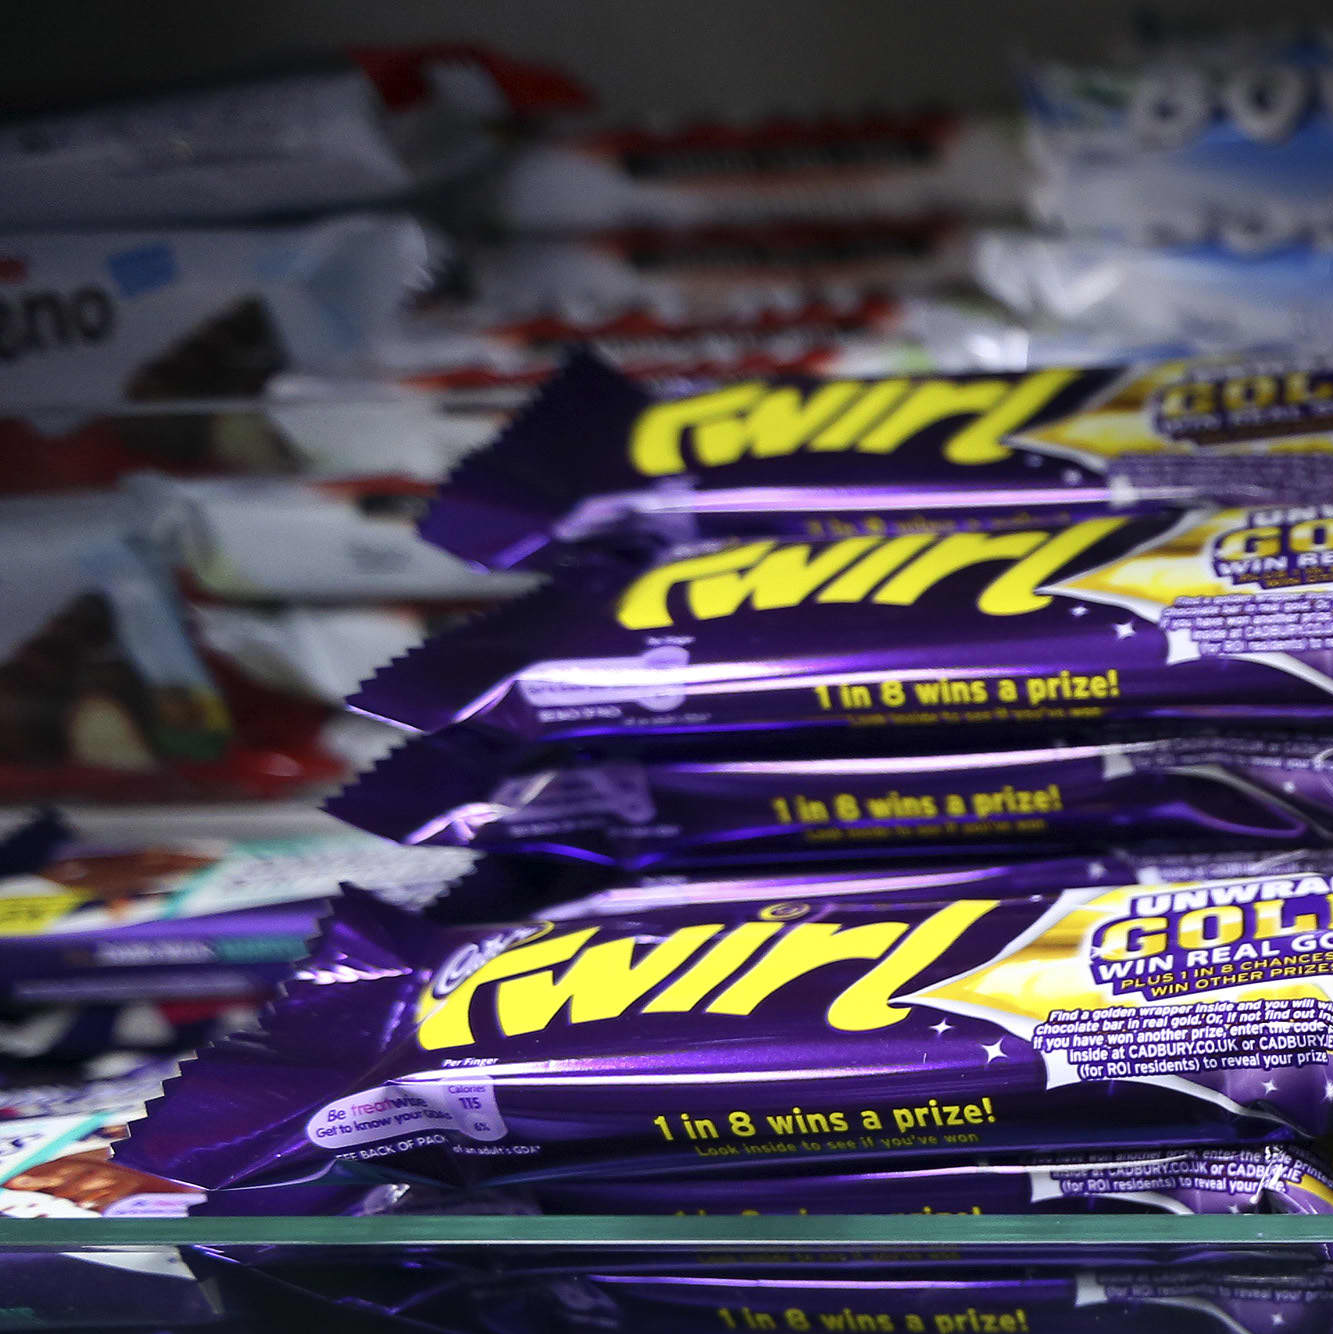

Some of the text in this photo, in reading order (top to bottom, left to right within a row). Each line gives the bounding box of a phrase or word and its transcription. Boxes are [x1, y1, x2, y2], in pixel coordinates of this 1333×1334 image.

[616, 517, 1129, 630] Twirl
[1217, 556, 1288, 575] WIN
[813, 669, 1120, 710] 1 in 8 wins a prize!
[1100, 952, 1180, 981] WIN
[1186, 940, 1280, 968] REAL
[418, 899, 1000, 1051] Twirl
[1121, 971, 1175, 990] PLUS
[1179, 968, 1189, 982] 1
[1193, 965, 1215, 980] IN
[1220, 962, 1236, 975] 8
[1151, 981, 1191, 998] WIN
[1195, 970, 1264, 990] OTHER
[1036, 1020, 1100, 1035] chocolate
[1102, 1019, 1125, 1033] bar
[1128, 1018, 1140, 1031] in
[1143, 1015, 1167, 1029] real
[1239, 1011, 1261, 1022] not
[1264, 1009, 1291, 1022] find
[1293, 1009, 1316, 1020] out
[1050, 1010, 1079, 1022] Find
[1093, 1007, 1136, 1022] golden
[1139, 1004, 1191, 1019] wrapper
[1237, 1000, 1262, 1011] and
[1264, 1000, 1289, 1012] you
[1293, 999, 1315, 1009] will
[1033, 1036, 1044, 1050] if
[1045, 1036, 1070, 1053] you
[1073, 1033, 1105, 1048] have
[1107, 1033, 1134, 1045] won
[1137, 1028, 1189, 1043] another
[1230, 1023, 1267, 1036] enter
[1293, 1019, 1325, 1033] code
[1111, 1046, 1126, 1060] at
[1129, 1037, 1239, 1058] CADBURY.CO.UK
[1241, 1039, 1256, 1051] or
[442, 1056, 500, 1068] Per Finger
[1080, 1063, 1103, 1079] (for
[1107, 1062, 1131, 1076] ROI
[1135, 1057, 1200, 1075] residents)
[1203, 1056, 1218, 1069] to
[1222, 1052, 1260, 1067] reveal
[1263, 1052, 1293, 1069] your
[316, 1124, 338, 1139] Get
[339, 1122, 354, 1135] to
[354, 1117, 392, 1132] know
[394, 1110, 426, 1126] your
[653, 1097, 997, 1141] 1 in 8 wins a prize!
[695, 1143, 741, 1158] Look
[742, 1140, 798, 1156] inside
[801, 1139, 823, 1152] to
[827, 1138, 858, 1150] see
[943, 1130, 981, 1144] won
